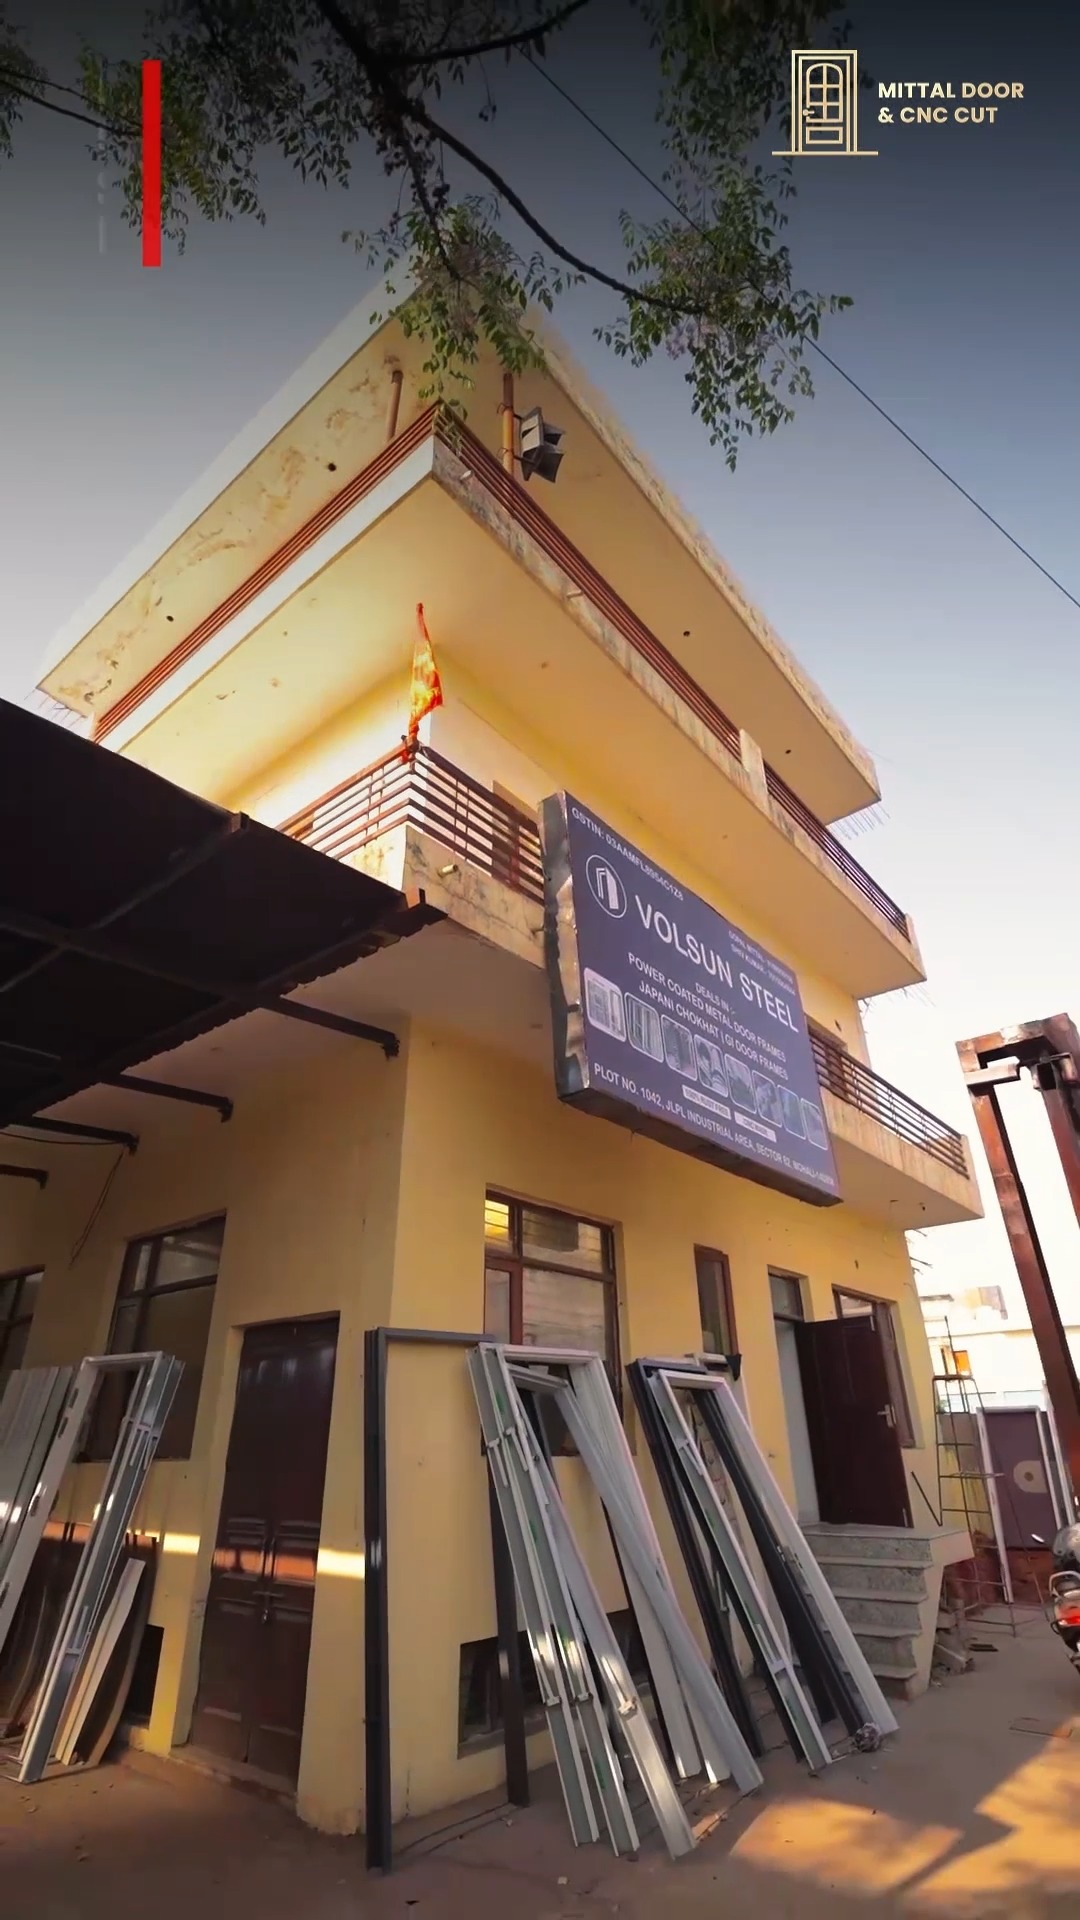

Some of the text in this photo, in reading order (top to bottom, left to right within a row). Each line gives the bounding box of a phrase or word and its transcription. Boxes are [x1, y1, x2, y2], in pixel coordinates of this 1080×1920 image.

[571, 806, 604, 839] GSTIN:
[628, 952, 786, 1063] POWER COATED METAL DOOR FRAMES
[635, 894, 798, 1034] VOLSUN STEEL
[695, 982, 720, 1006] DEALS
[638, 978, 674, 1011] JAPANI
[675, 1002, 719, 1039] CHOKHAT
[734, 1039, 758, 1063] DOOR
[759, 1054, 789, 1081] FRAMES
[594, 1061, 619, 1086] PLOT
[621, 1076, 638, 1095] NO.
[640, 1086, 664, 1110] 1042,
[665, 1098, 685, 1119] JLPL
[687, 1109, 733, 1141] INDUSTRIAL
[734, 1131, 755, 1152] AREA,
[755, 1142, 782, 1164] SECTOR
